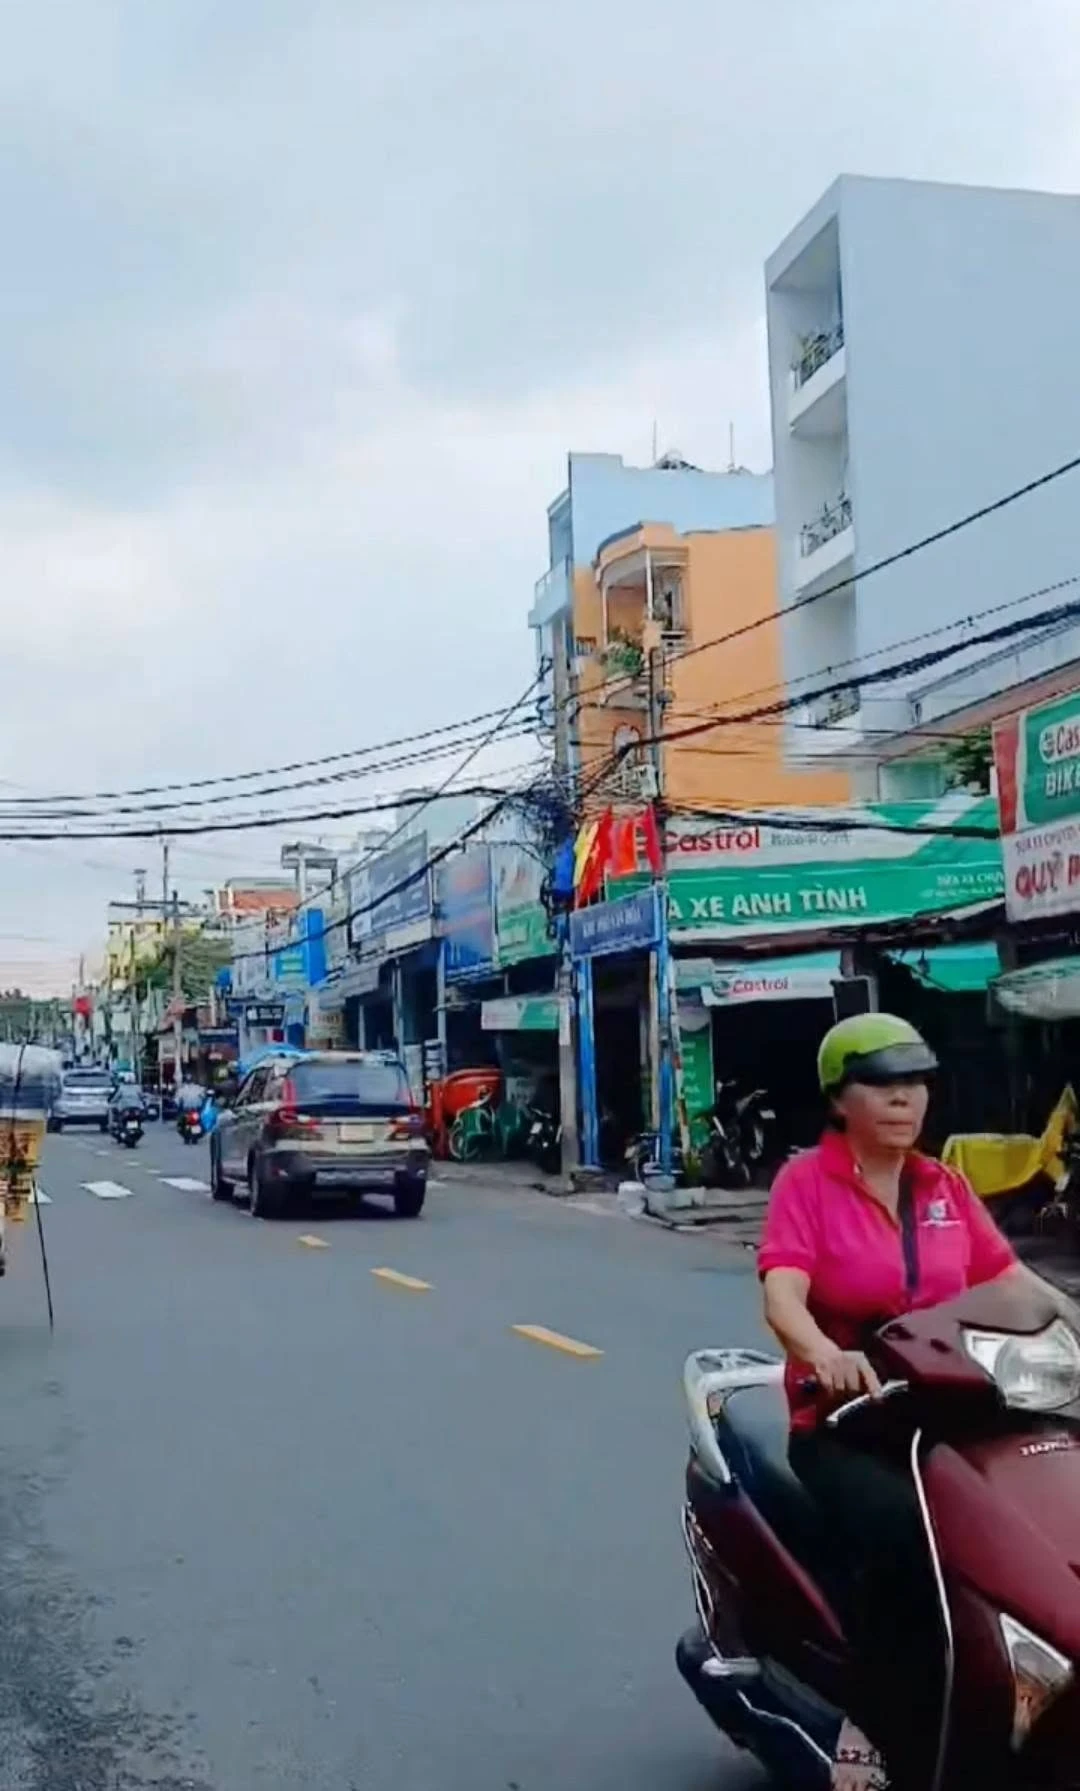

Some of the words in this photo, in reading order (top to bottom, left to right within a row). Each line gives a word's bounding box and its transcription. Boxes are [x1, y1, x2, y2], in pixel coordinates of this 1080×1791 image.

[661, 825, 760, 853] Castrol
[689, 896, 725, 918] XE
[732, 892, 792, 917] ANH
[798, 882, 868, 911] TÌNH
[732, 977, 789, 994] Castrol
